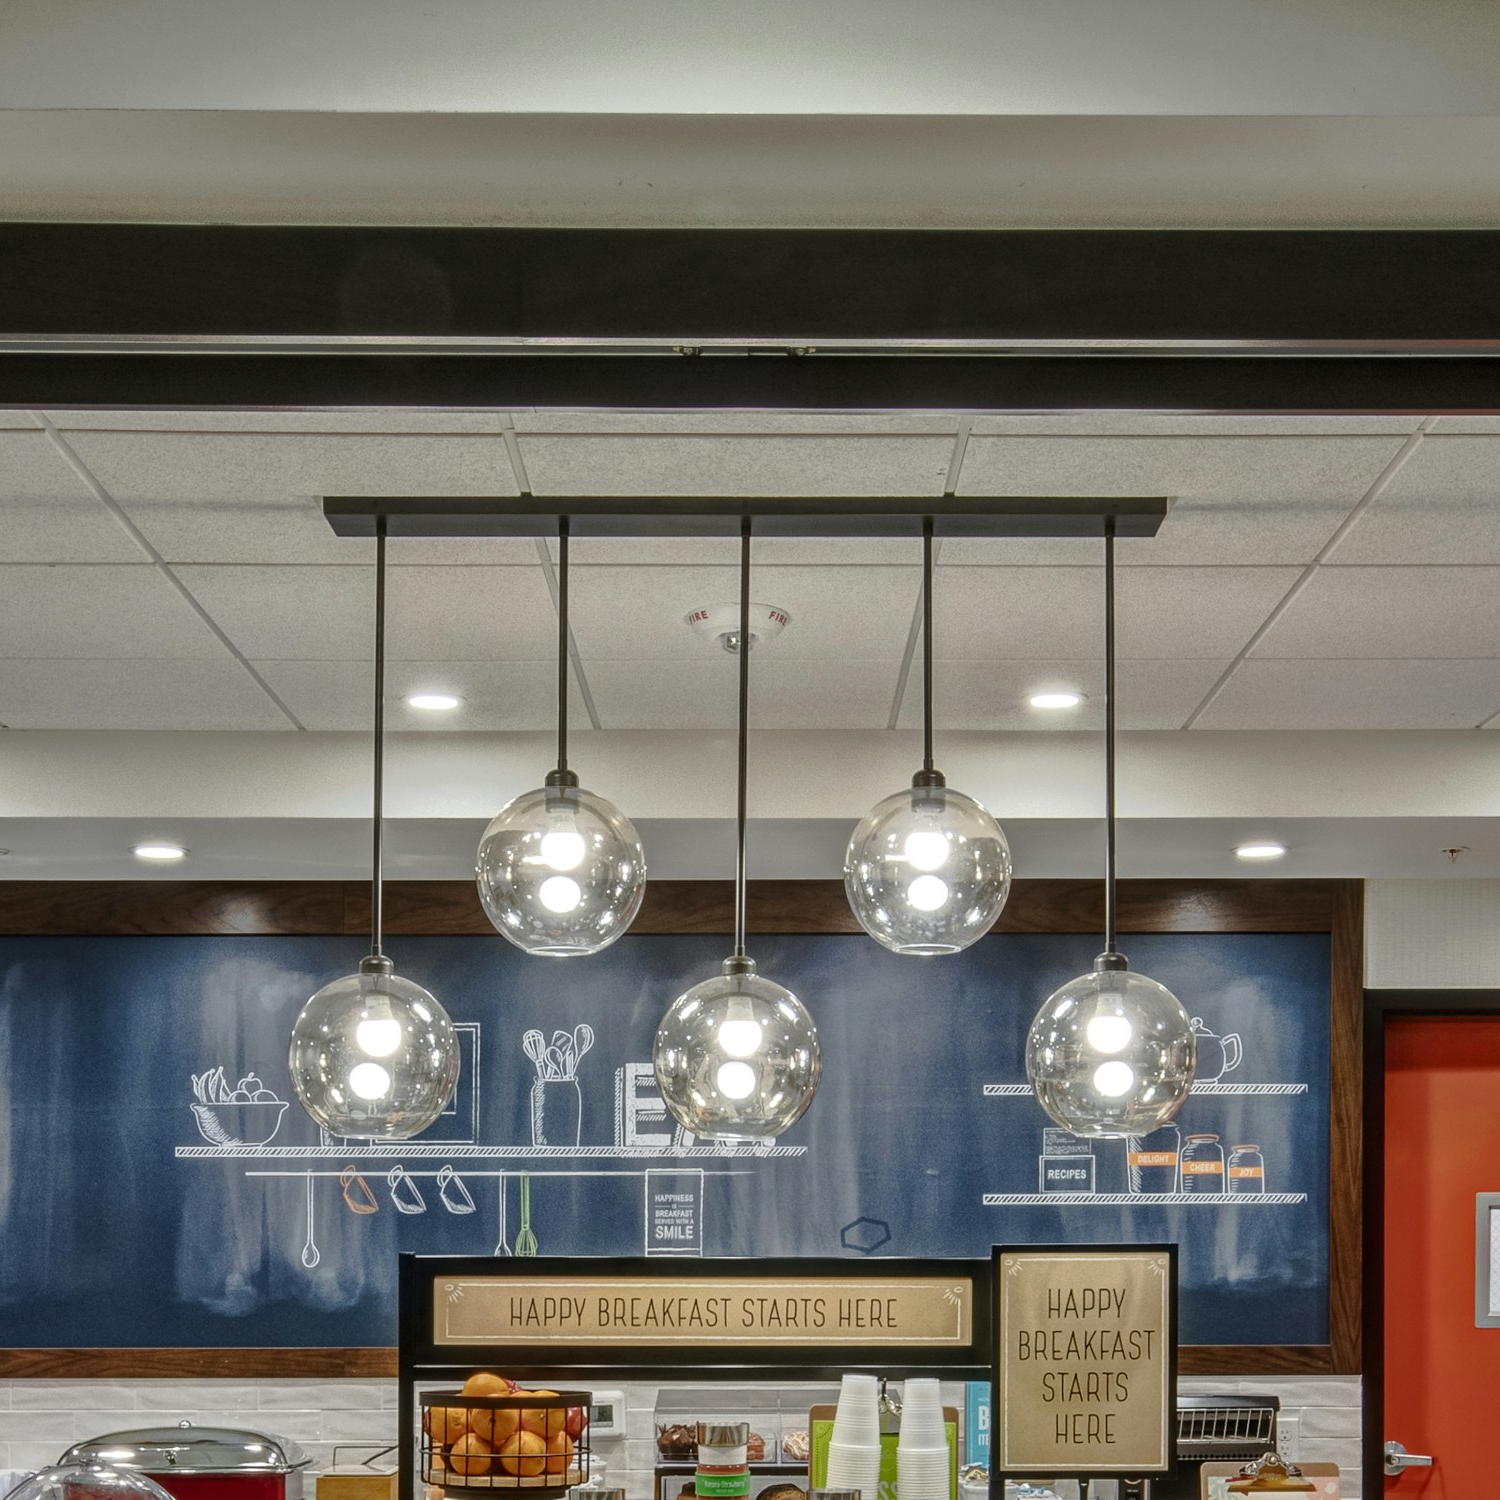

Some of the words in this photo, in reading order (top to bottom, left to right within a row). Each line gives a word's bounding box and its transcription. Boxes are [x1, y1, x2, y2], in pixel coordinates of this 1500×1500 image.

[1137, 1155, 1169, 1163] DELIGHT
[1047, 1169, 1087, 1180] RECIPES
[1189, 1163, 1215, 1172] CHEER
[1239, 1168, 1254, 1177] JOY
[655, 1194, 694, 1202] HAPPINESS
[655, 1225, 694, 1239] SMILE
[1048, 1288, 1126, 1319] HAPPY
[510, 1297, 586, 1328] HAPPY
[598, 1297, 732, 1328] BREAKFAST
[741, 1298, 826, 1328] STARTS
[839, 1298, 898, 1328] HERE
[1019, 1330, 1155, 1361] BREAKFAST
[1042, 1372, 1129, 1402] STARTS
[1055, 1413, 1116, 1444] HERE
